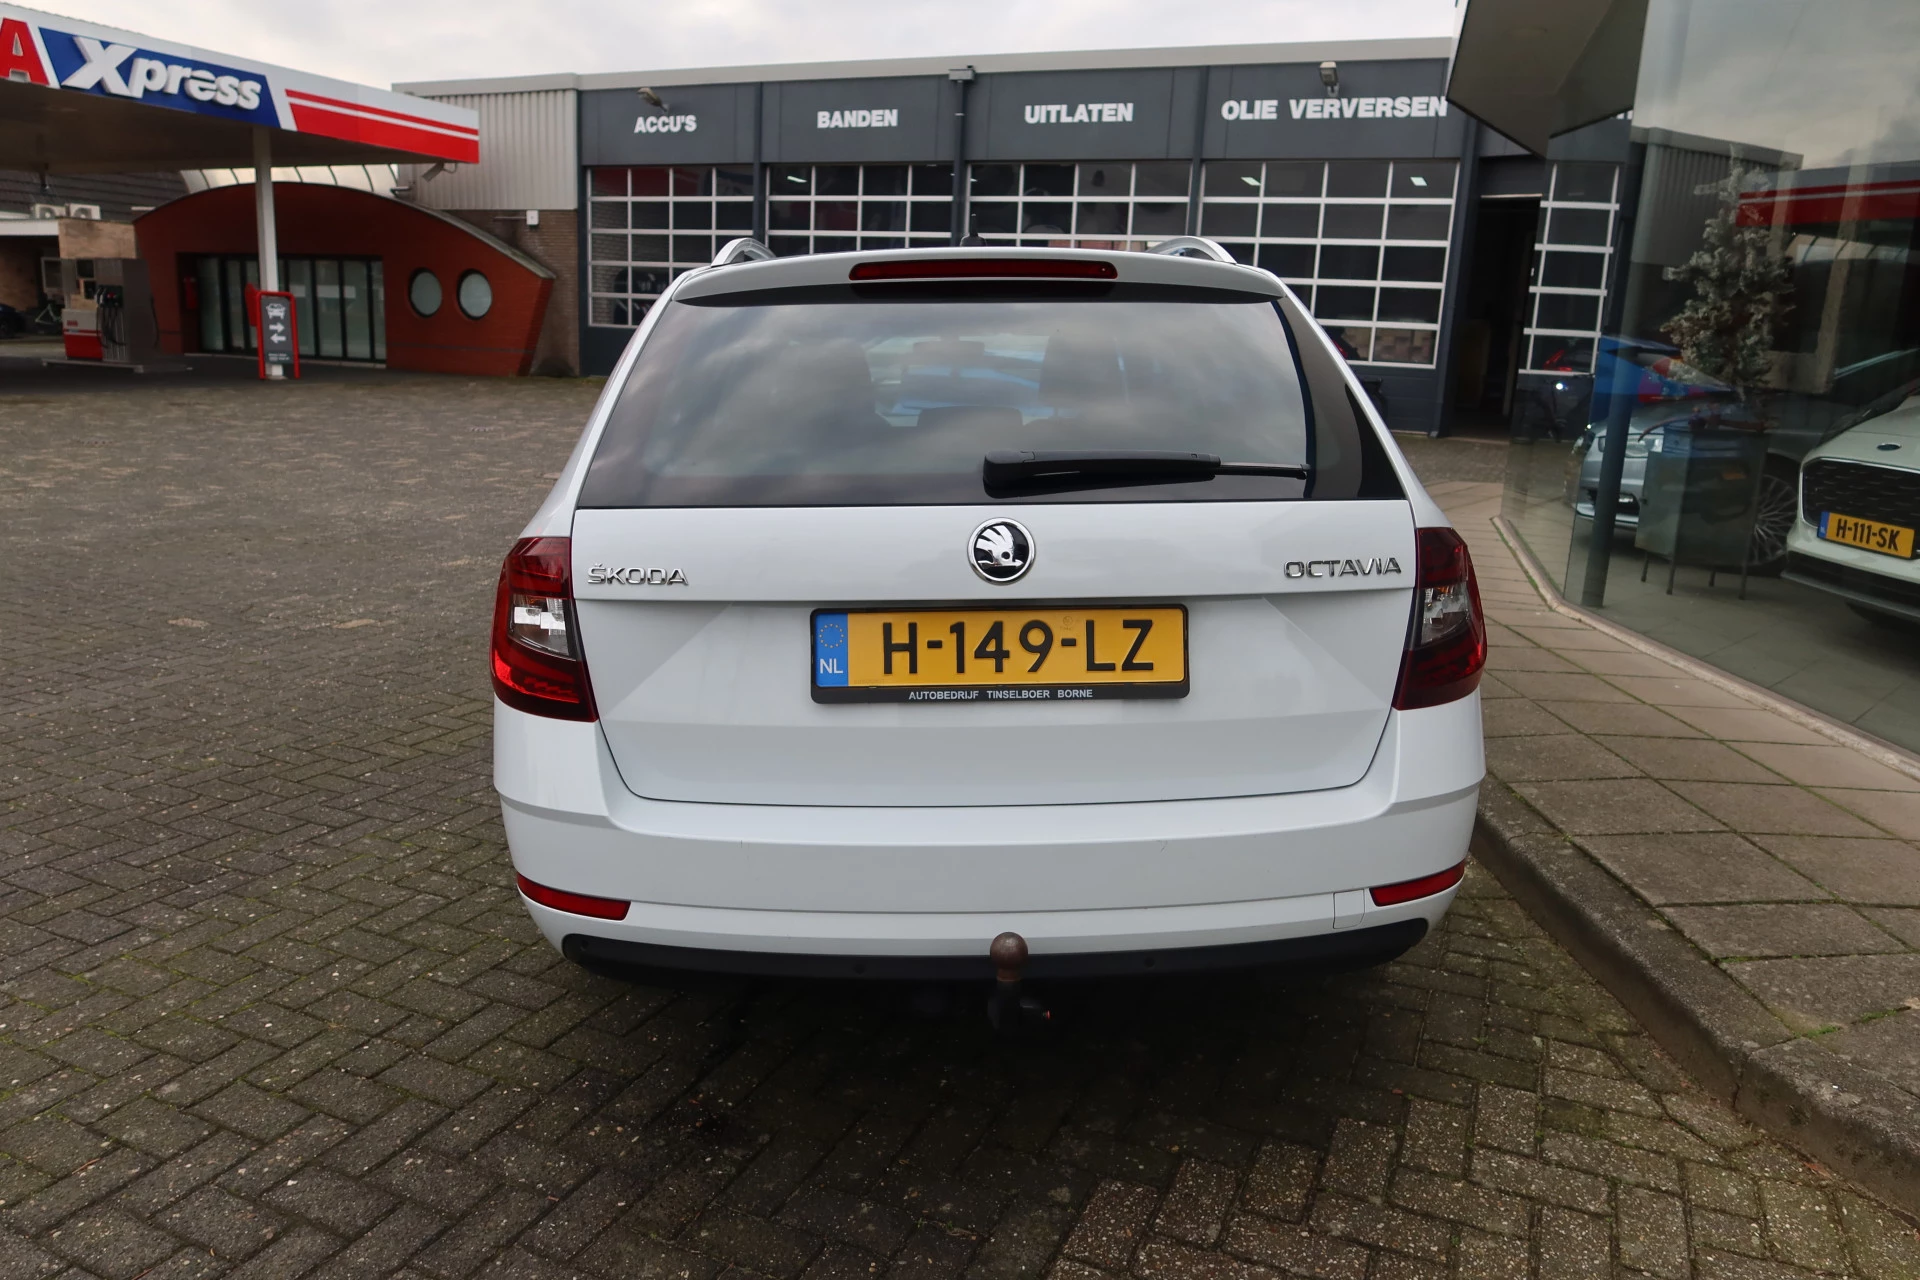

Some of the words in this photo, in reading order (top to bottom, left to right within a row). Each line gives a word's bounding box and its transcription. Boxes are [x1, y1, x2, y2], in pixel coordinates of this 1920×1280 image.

[60, 36, 262, 111] Xpress
[816, 109, 899, 129] BANDEN
[1024, 103, 1135, 125] UITLATEN
[1221, 100, 1278, 121] OLIE
[1289, 97, 1448, 120] VERVERSEN
[633, 115, 698, 134] ACCU'S
[1836, 518, 1900, 551] H-111-SK
[587, 563, 690, 587] ŠKODA
[1284, 557, 1402, 580] OCTAVIA
[882, 619, 1154, 675] H-149-LZ
[819, 658, 844, 674] NL
[908, 690, 980, 701] AUTOBEDRIJF
[986, 689, 1051, 700] TINSELBOER
[1057, 688, 1094, 699] BORNE
